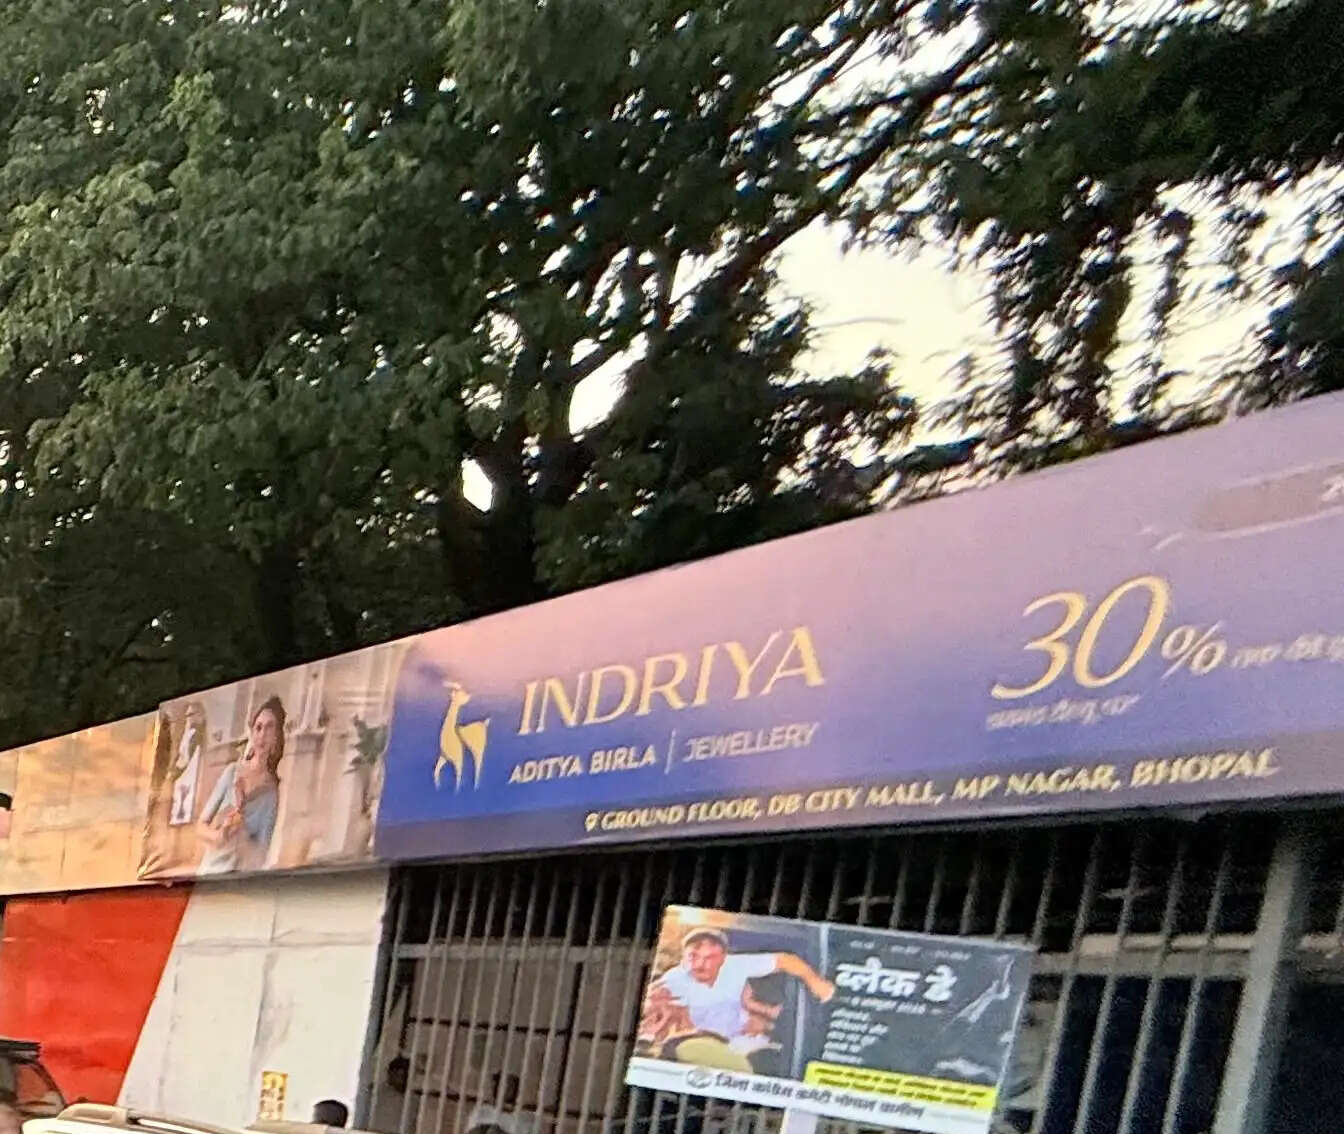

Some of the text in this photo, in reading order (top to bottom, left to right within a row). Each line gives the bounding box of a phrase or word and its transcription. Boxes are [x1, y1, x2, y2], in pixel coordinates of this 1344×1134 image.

[518, 625, 826, 736] INDRIYA
[508, 721, 820, 785] ADITYA BIRLA JEWELLERY
[601, 747, 1282, 832] GROUND FLOOR, DB CITY MALL, MP NAGAR, BHOPAL
[835, 957, 959, 1002] ब्लैक डे
